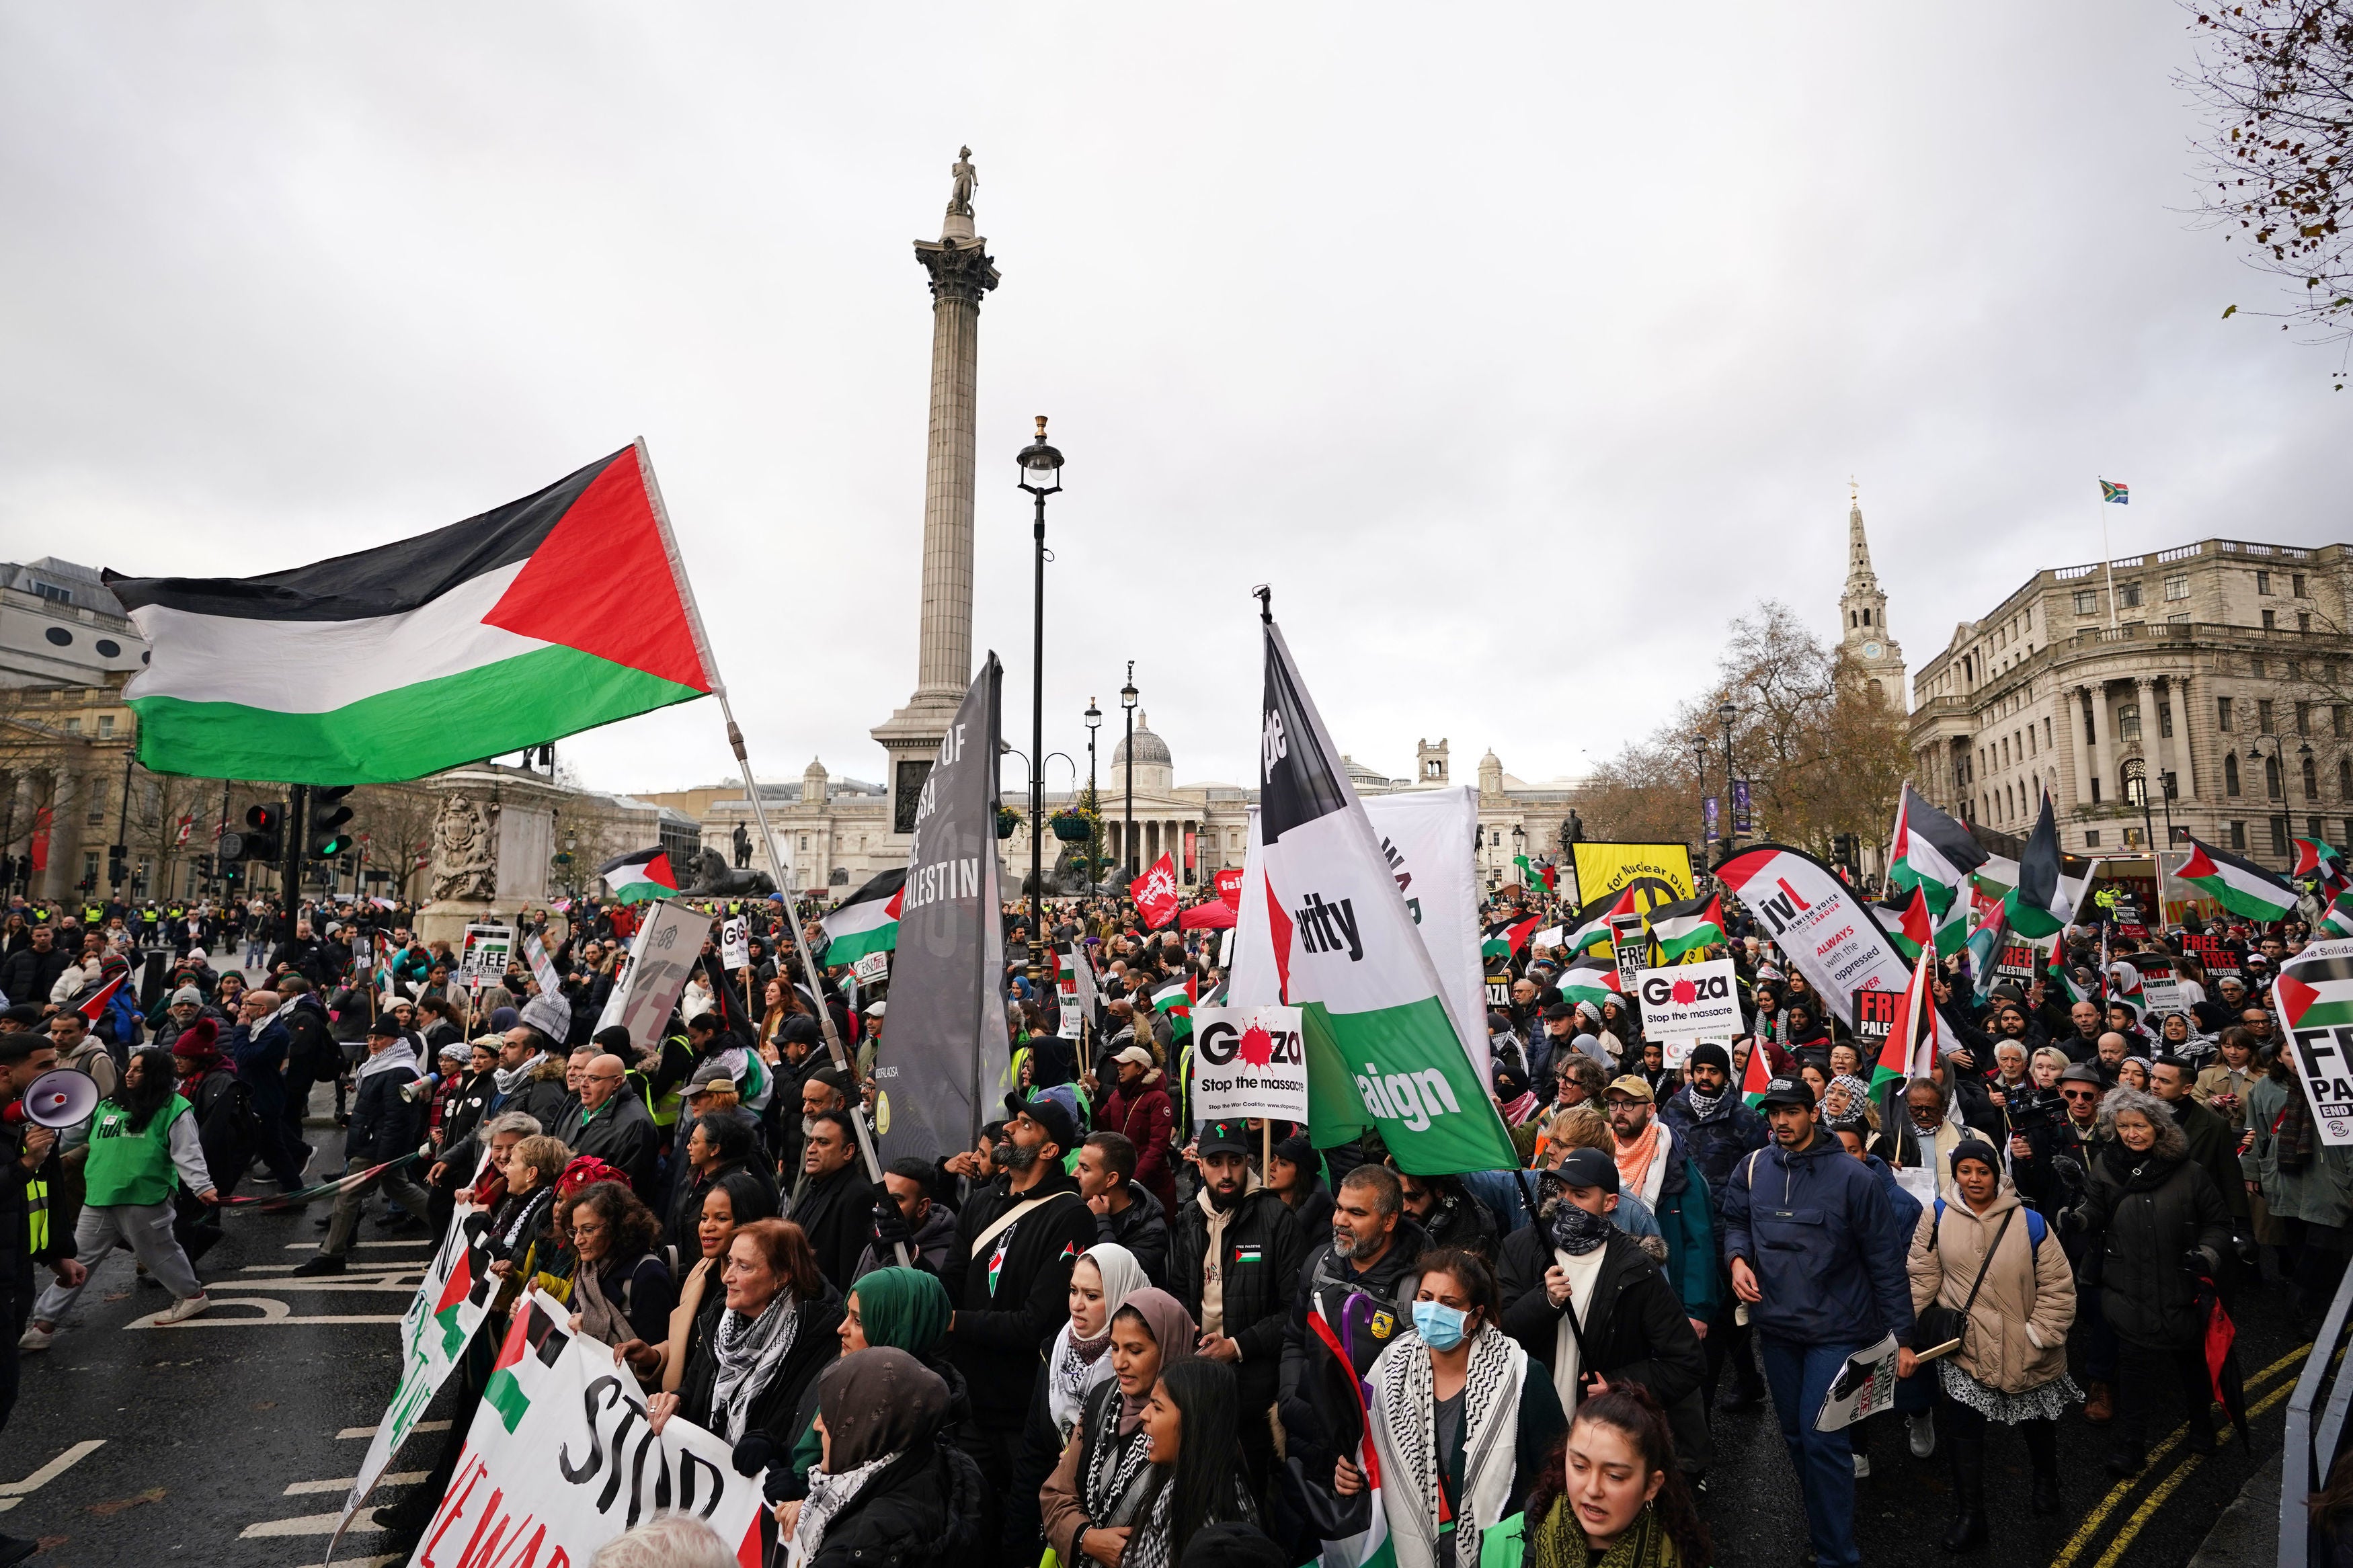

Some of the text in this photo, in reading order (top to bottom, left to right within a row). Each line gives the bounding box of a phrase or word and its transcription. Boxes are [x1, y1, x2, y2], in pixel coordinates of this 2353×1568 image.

[943, 723, 965, 766] OF
[1607, 872, 1624, 892] for
[1621, 862, 1667, 875] Nuclear
[1759, 877, 1811, 936] jvl
[1788, 893, 1839, 932] JEWISH VOICE
[1798, 903, 1841, 936] FOR LABOUR
[1295, 893, 1363, 962] arity
[1816, 925, 1854, 957] ALWAYS
[1824, 941, 1859, 968] with the
[2183, 935, 2220, 950] FREE
[1834, 945, 1880, 981] oppressed
[2201, 952, 2239, 968] FREE
[2206, 968, 2242, 977] PALESTINE
[2143, 968, 2171, 981] FREE
[2143, 979, 2177, 989] PALESTINE
[1648, 1007, 1732, 1023] Stop the massacre
[1201, 1076, 1304, 1093] Stop the massacre
[2320, 1106, 2350, 1117] END
